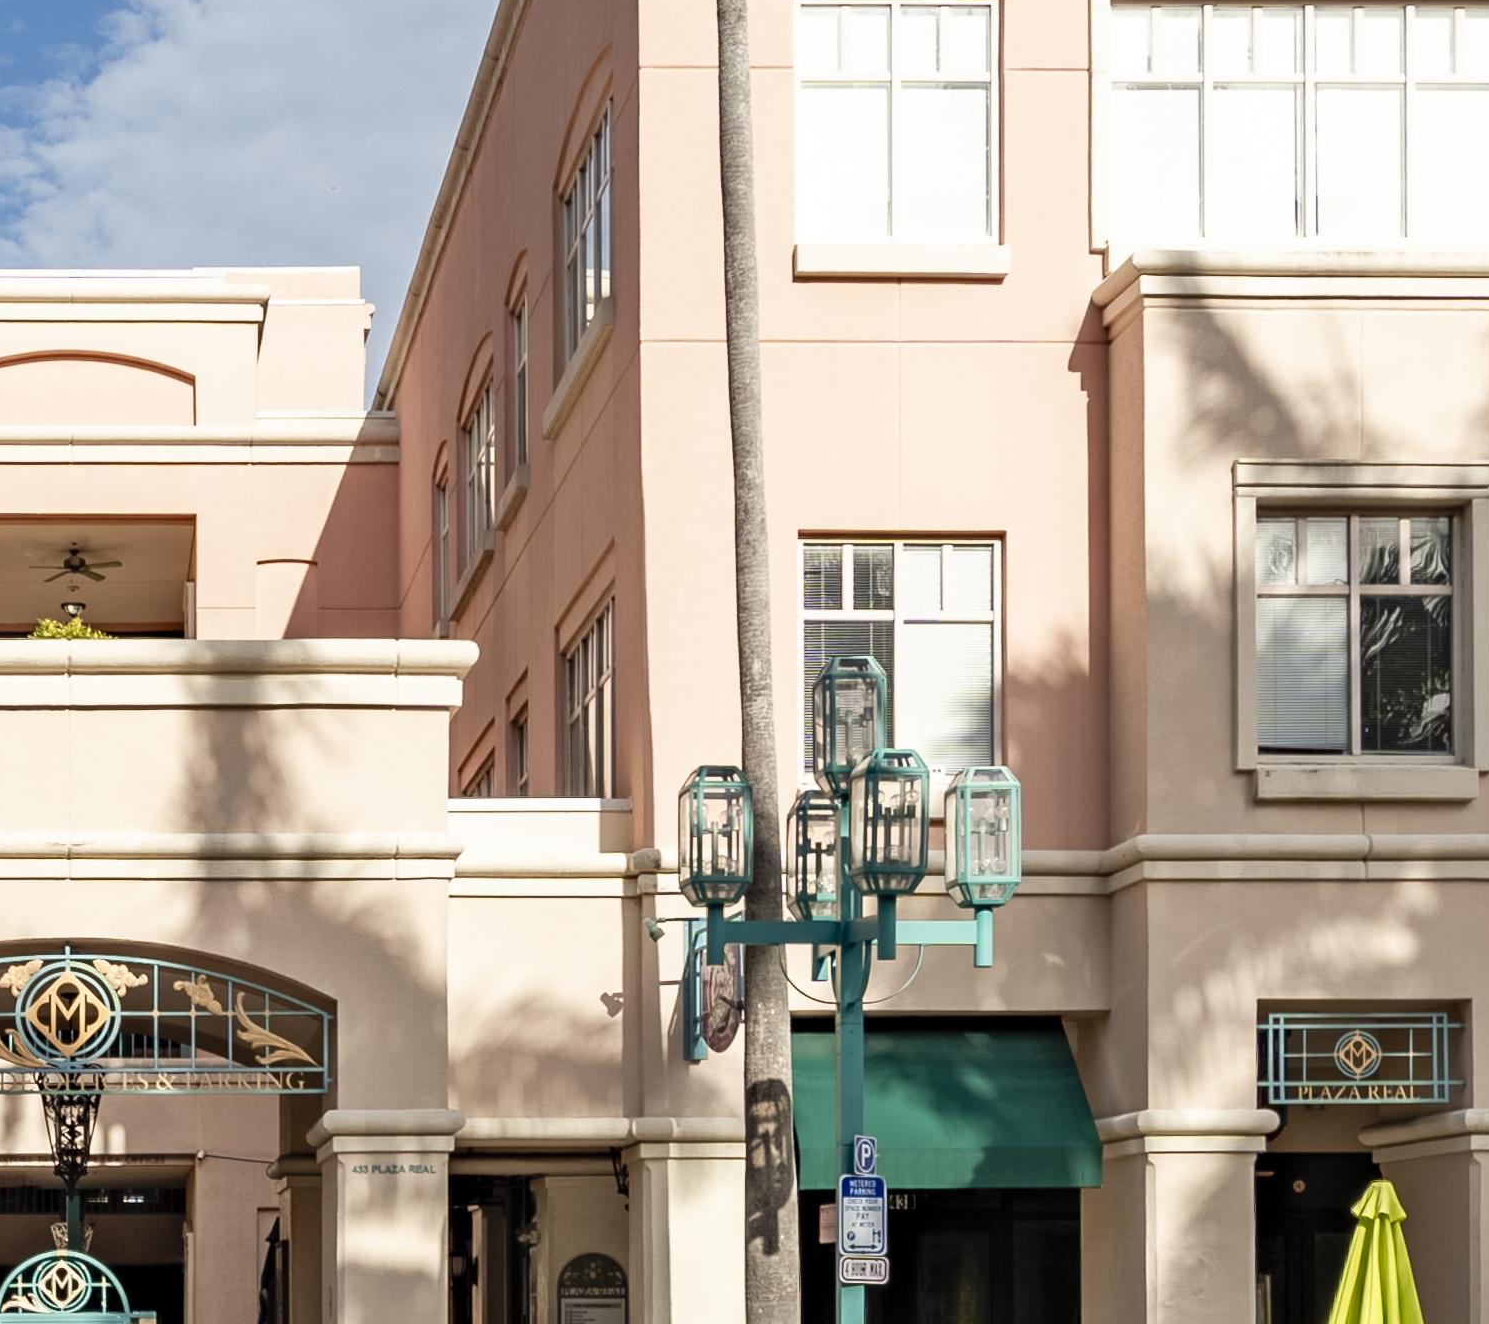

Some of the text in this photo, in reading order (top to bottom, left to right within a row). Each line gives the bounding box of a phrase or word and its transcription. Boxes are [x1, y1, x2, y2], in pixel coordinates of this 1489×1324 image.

[155, 1072, 176, 1091] &
[186, 1071, 306, 1091] PARKING
[1298, 1085, 1421, 1100] PLAZA REAL
[861, 1143, 871, 1167] P
[371, 1164, 405, 1174] PLAZA
[408, 1164, 437, 1173] REAL
[849, 1180, 876, 1188] METERED
[849, 1188, 876, 1196] PARKING
